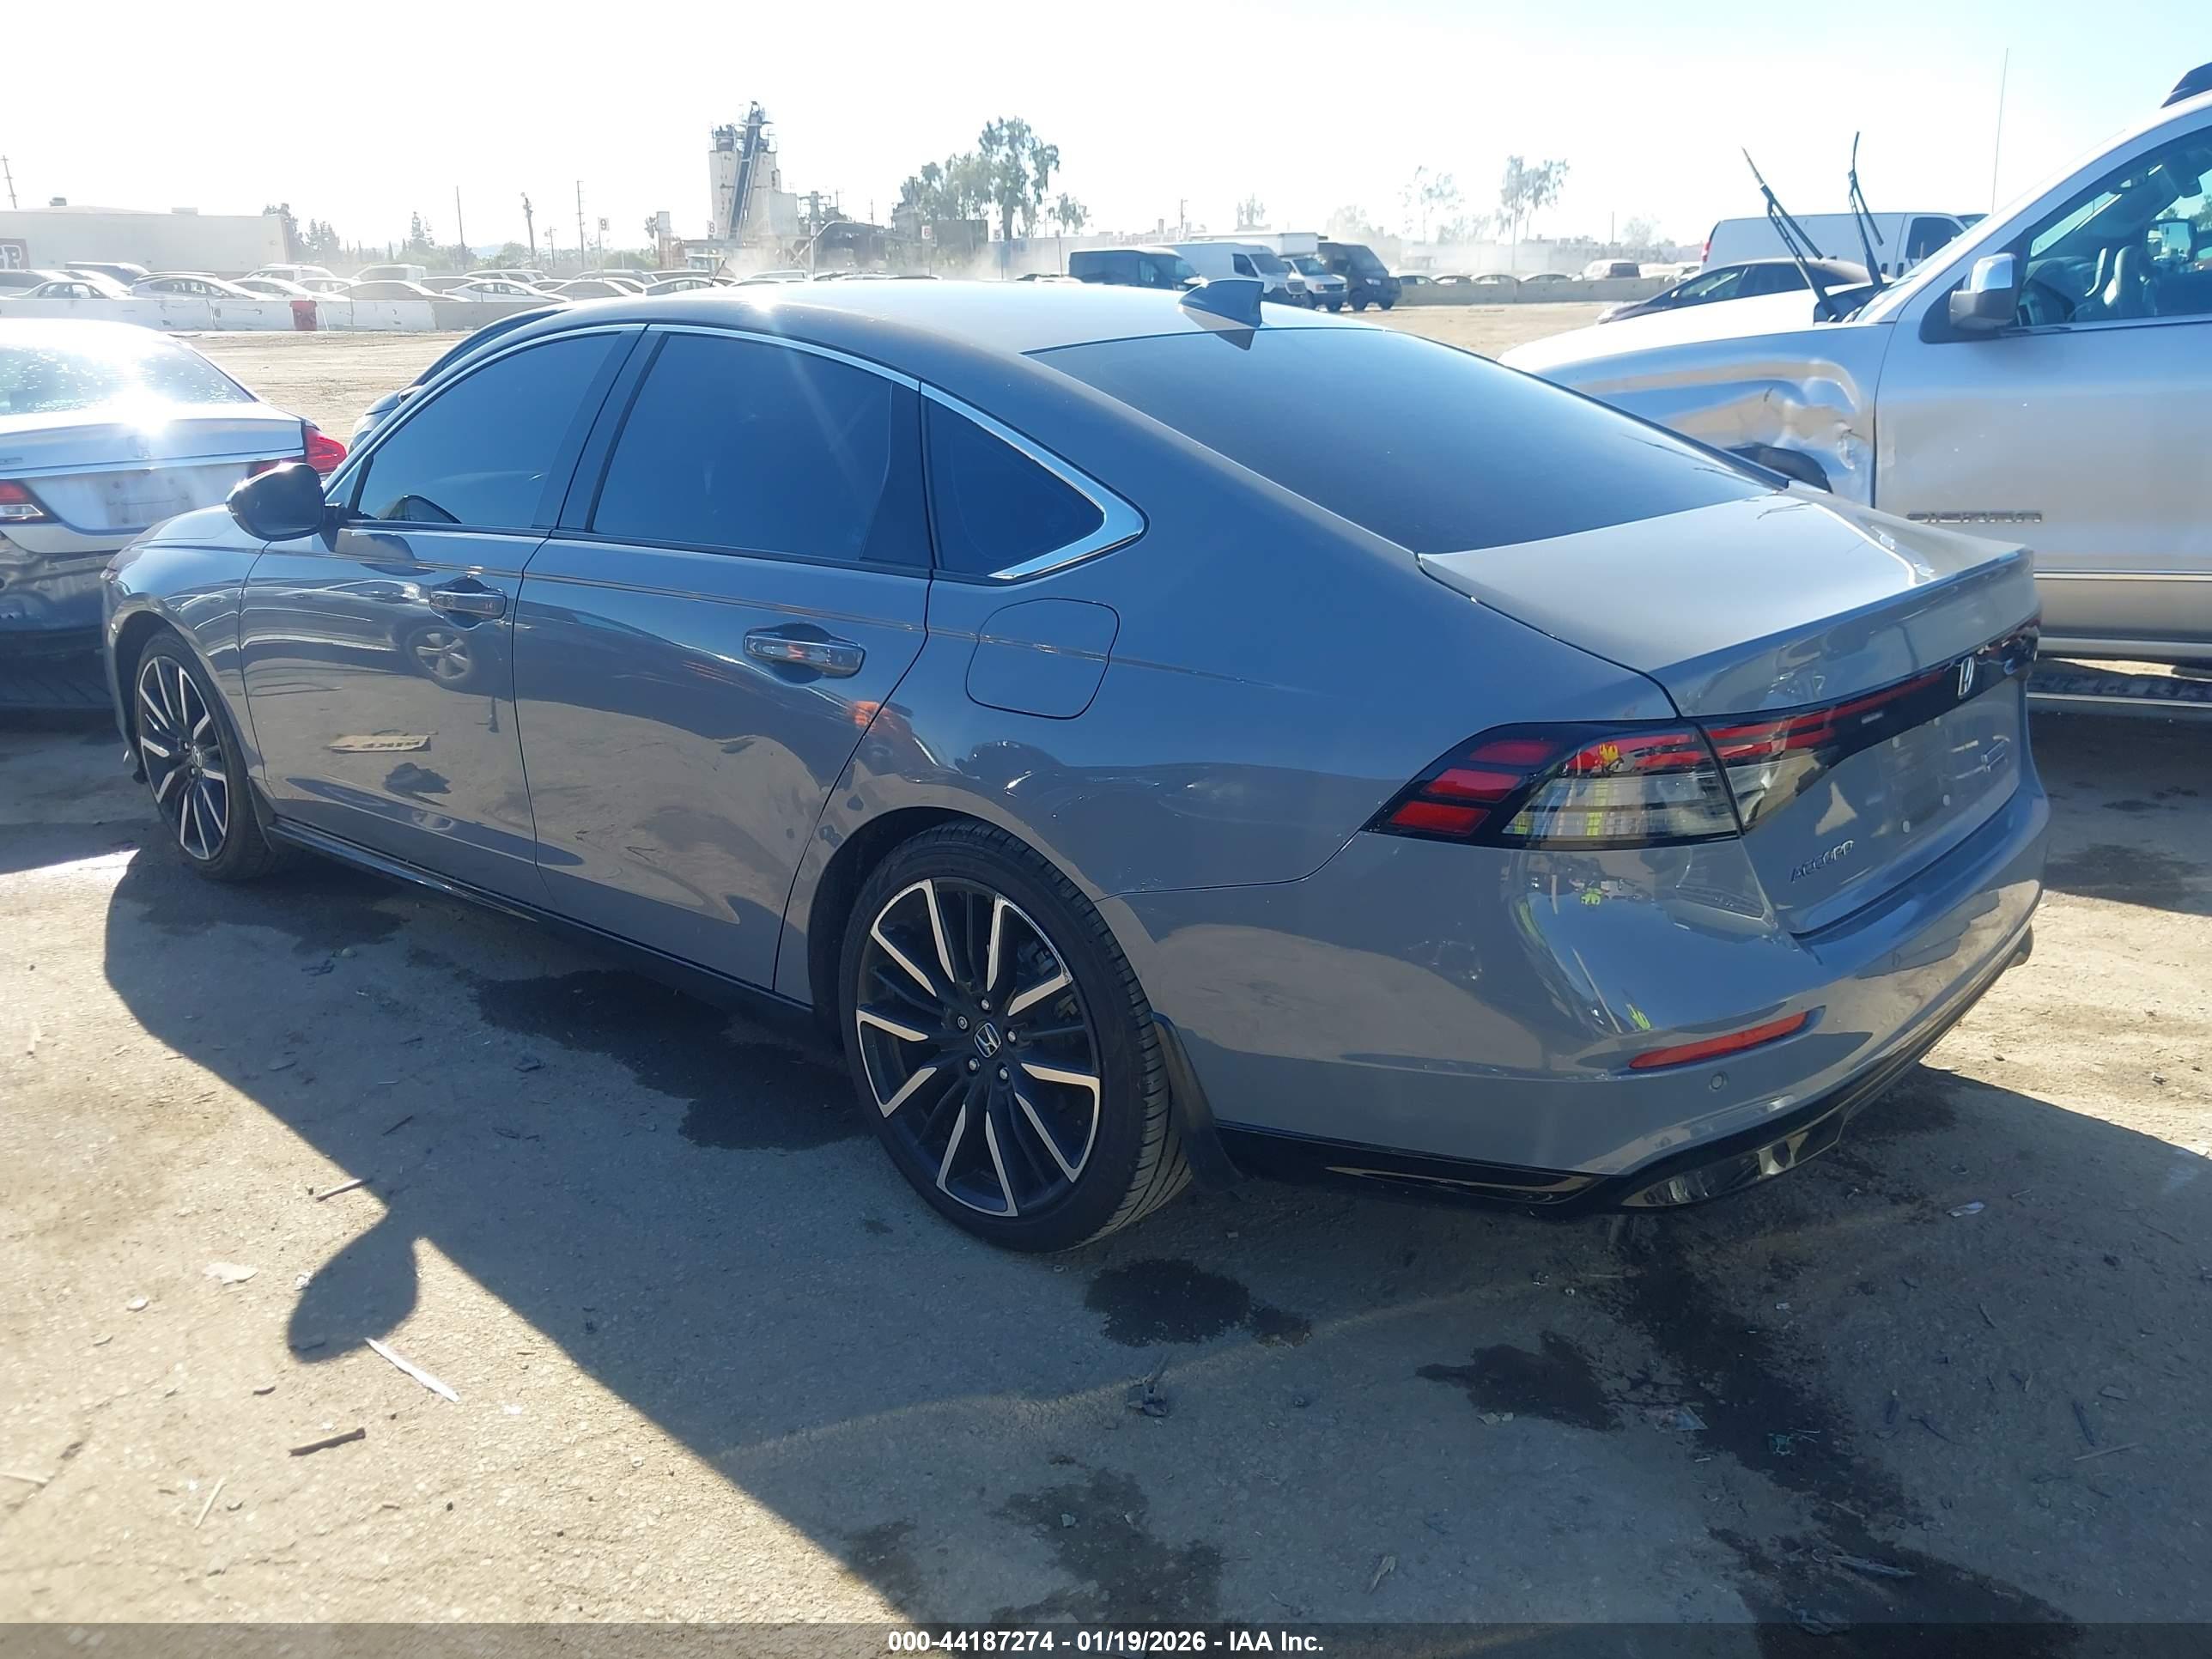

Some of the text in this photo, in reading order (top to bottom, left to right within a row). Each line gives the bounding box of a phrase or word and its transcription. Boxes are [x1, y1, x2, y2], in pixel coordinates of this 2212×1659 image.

[600, 218, 606, 231] 9
[708, 222, 715, 233] 8
[1790, 839, 1855, 883] ACCORD
